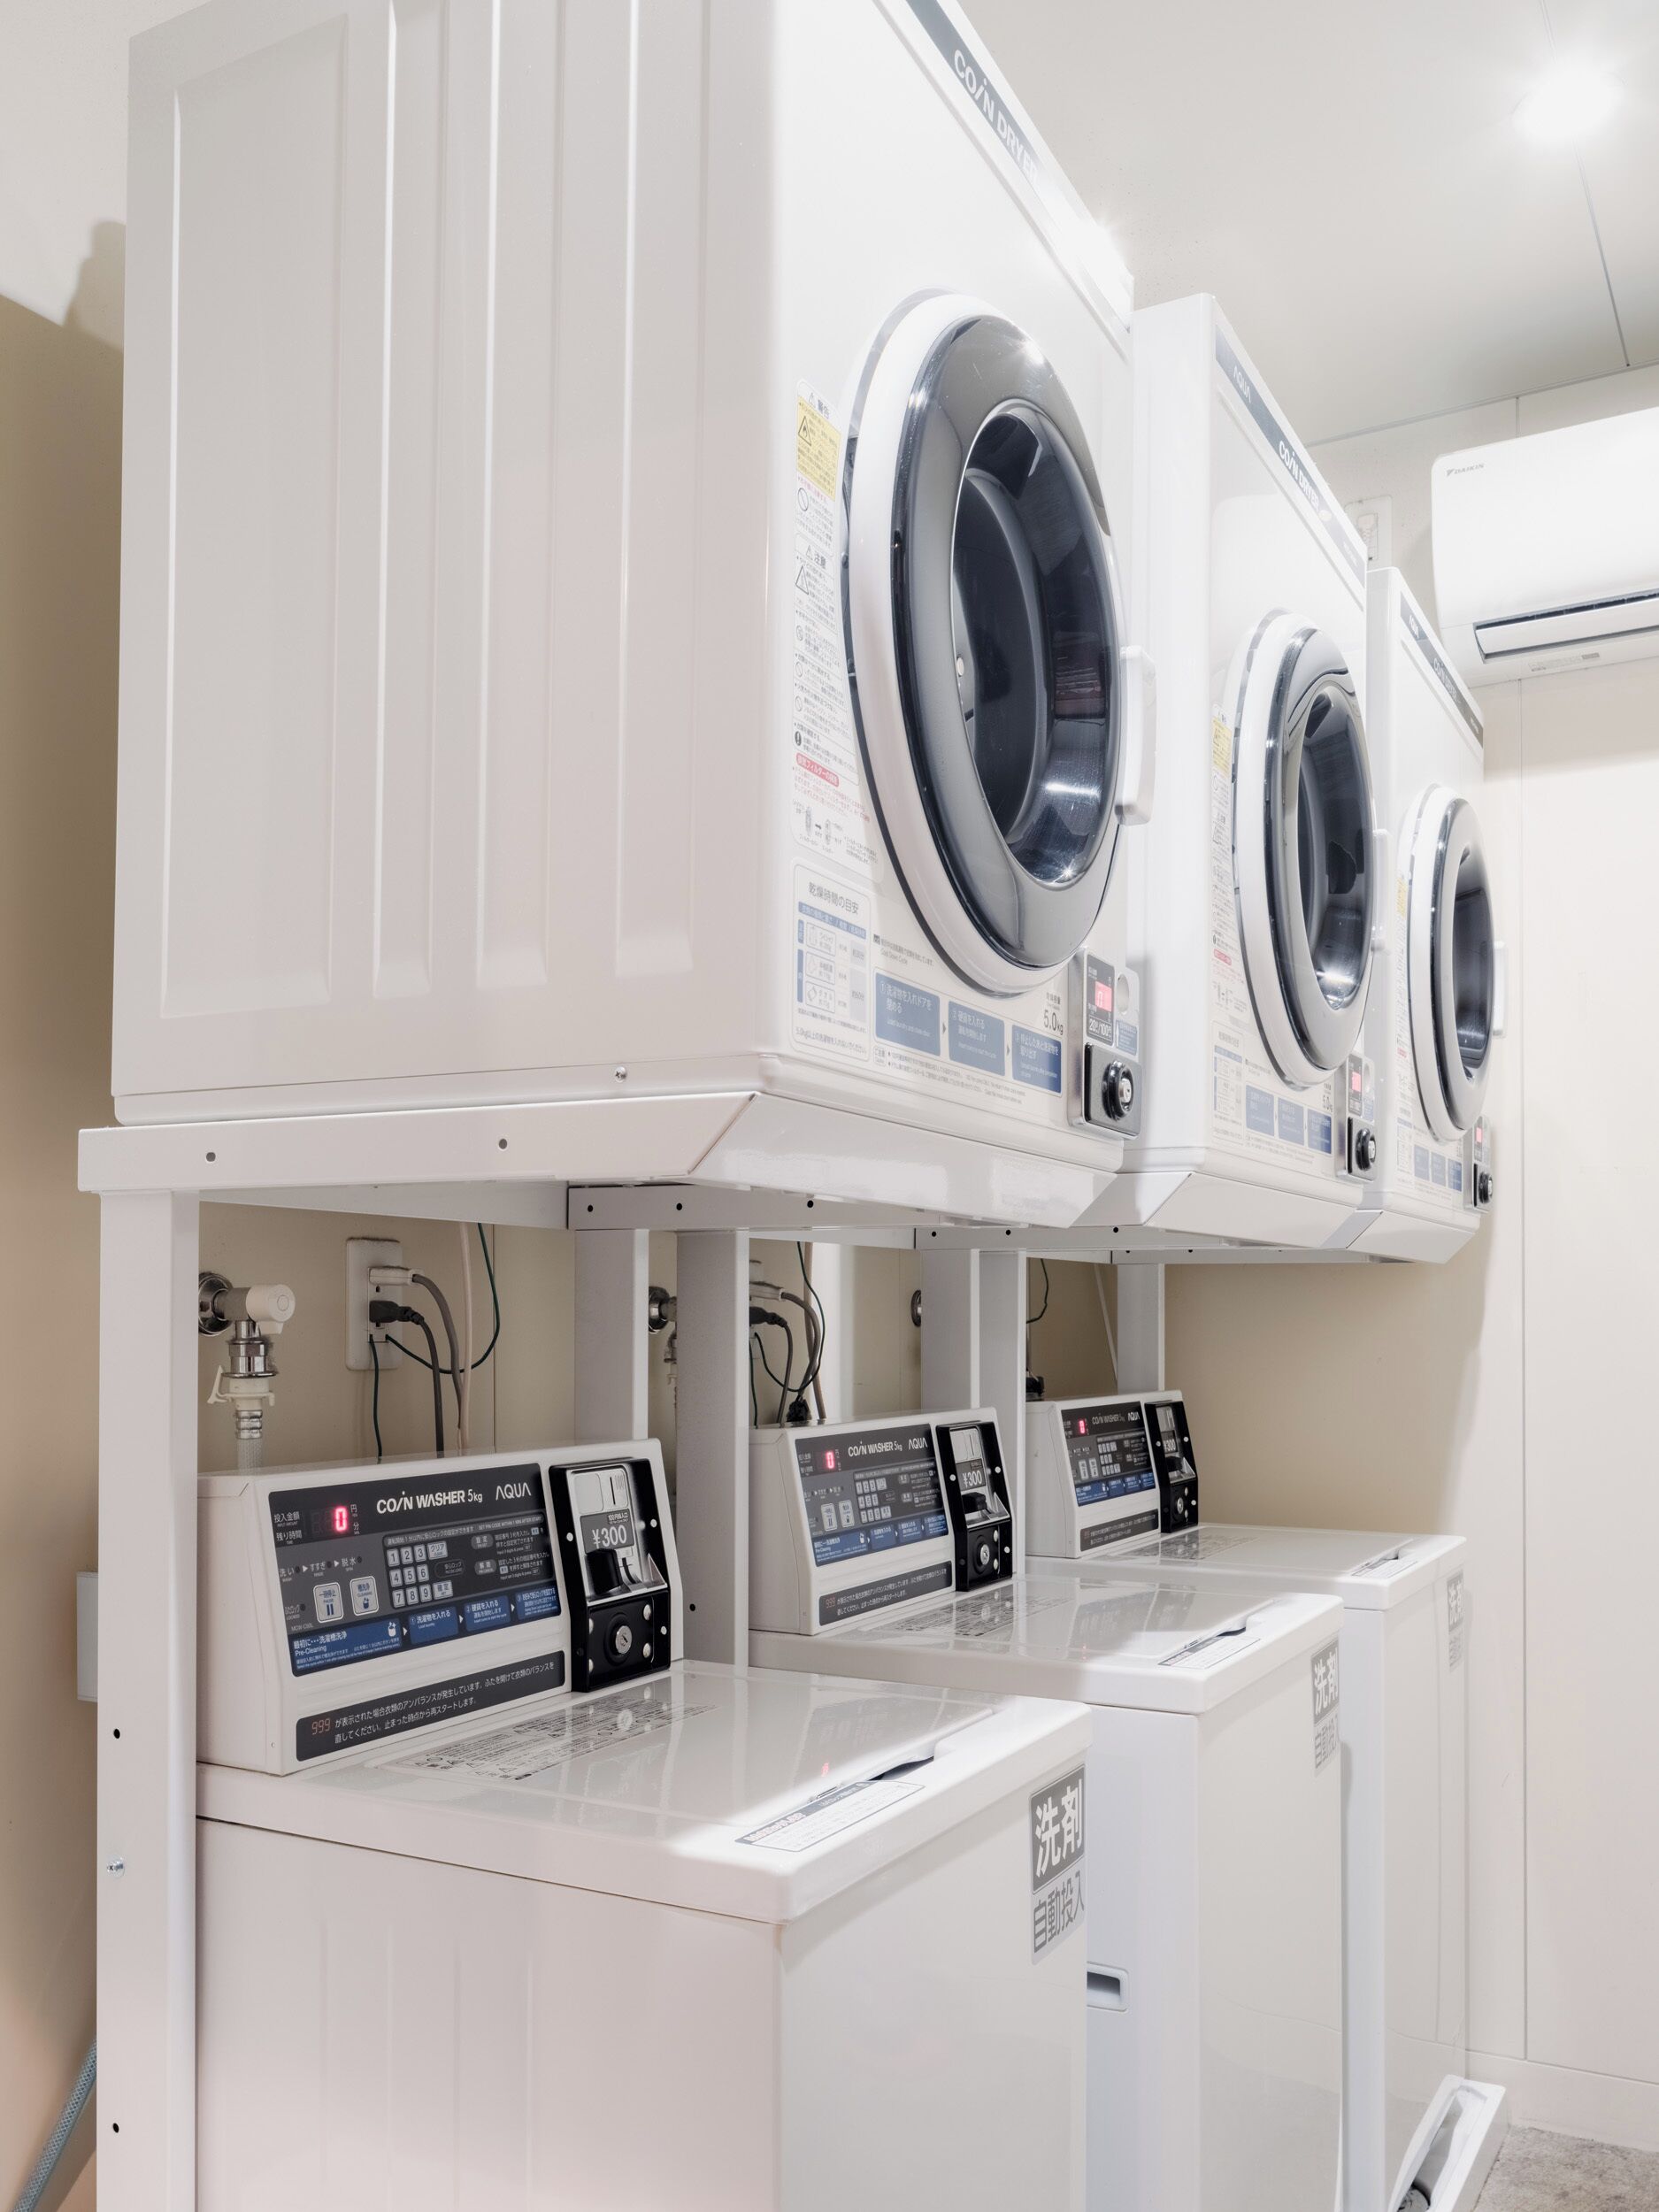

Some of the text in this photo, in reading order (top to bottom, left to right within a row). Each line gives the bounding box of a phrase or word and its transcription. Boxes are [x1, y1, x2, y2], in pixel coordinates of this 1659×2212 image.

[1454, 463, 1485, 475] DAIKIN
[809, 881, 859, 915] 乾燥時間の目安
[1044, 1009, 1064, 1036] 5.0kg
[1127, 1410, 1140, 1421] AQUA
[867, 1440, 894, 1455] WASHER
[907, 1436, 926, 1450] AQUA
[826, 1450, 834, 1470] 0
[962, 1470, 982, 1489] ¥300
[416, 1489, 465, 1509] WASHER
[466, 1487, 482, 1504] 5kg
[494, 1480, 531, 1501] AQUA
[273, 1510, 300, 1524] 投入金額
[350, 1503, 357, 1513] 円
[333, 1506, 348, 1532] 0
[353, 1521, 360, 1531] 分
[275, 1529, 302, 1541] 残り時間
[592, 1525, 626, 1548] ¥300
[404, 1549, 410, 1560] 2
[418, 1548, 423, 1558] 3
[430, 1543, 444, 1552] クリア
[310, 1561, 326, 1572] すすぎ
[394, 1568, 426, 1583] 4 5 6
[396, 1593, 401, 1603] 7
[410, 1590, 415, 1601] 8
[423, 1587, 428, 1598] 9
[295, 1643, 326, 1659] Pre-Cleaning
[1313, 1647, 1339, 1715] 洗剤
[311, 1717, 331, 1736] 999
[1035, 1778, 1083, 1878] 洗剤
[1033, 1870, 1085, 1954] 自動投入
